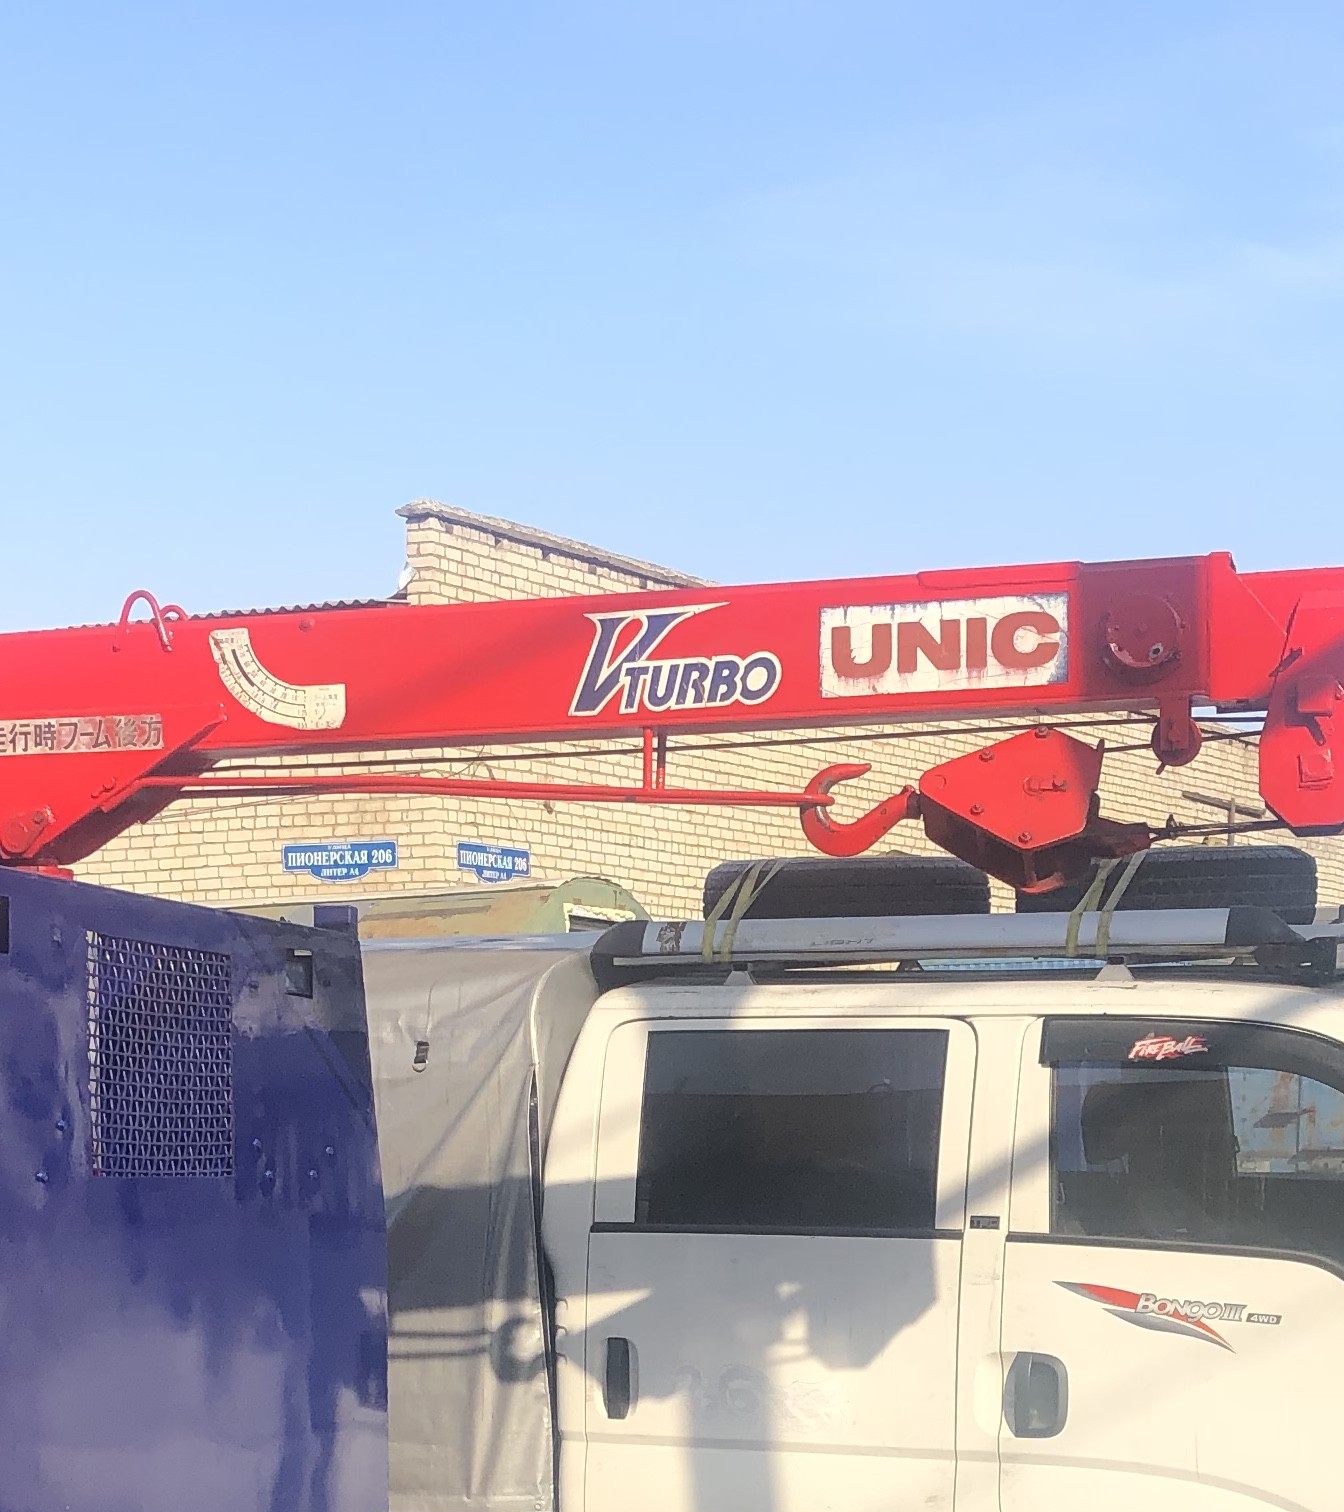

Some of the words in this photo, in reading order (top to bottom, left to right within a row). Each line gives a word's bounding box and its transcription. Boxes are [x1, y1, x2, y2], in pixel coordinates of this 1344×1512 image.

[831, 611, 1060, 679] UNIC
[620, 653, 780, 712] TURBO
[287, 850, 368, 867] ПИОНЕРСКАЯ
[371, 849, 393, 864] 206
[459, 850, 513, 870] ПИОНЕРСКАЯ
[514, 857, 527, 872] 206
[320, 868, 348, 877] ЛИТЕР
[1250, 1315, 1277, 1325] 4WD
